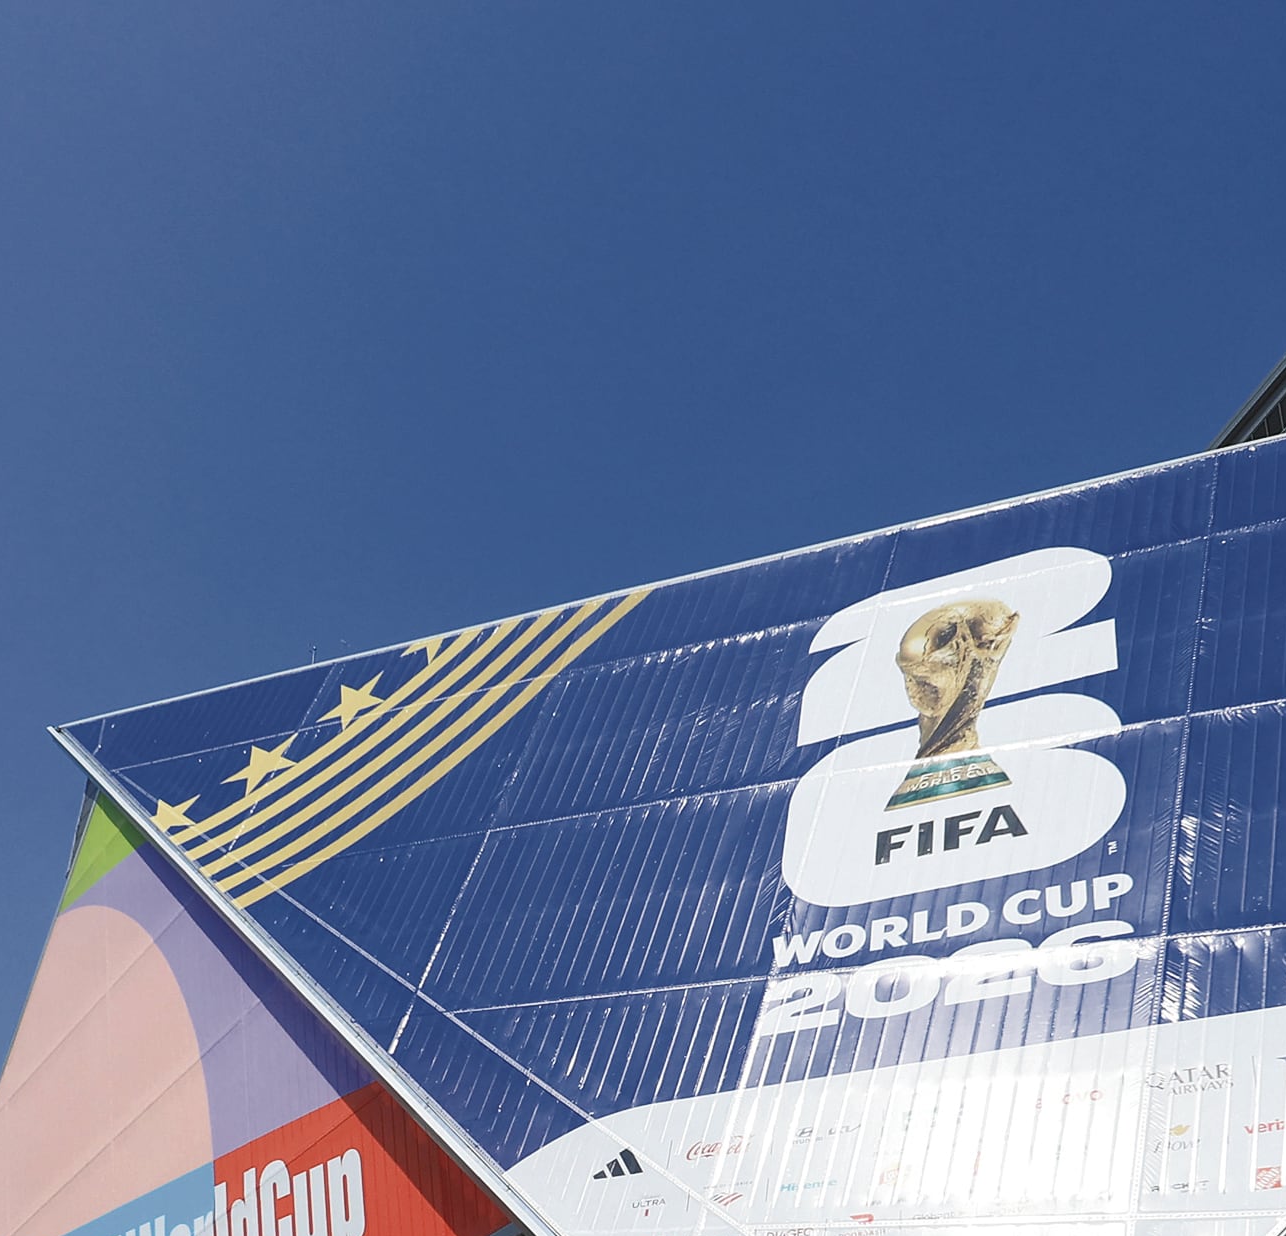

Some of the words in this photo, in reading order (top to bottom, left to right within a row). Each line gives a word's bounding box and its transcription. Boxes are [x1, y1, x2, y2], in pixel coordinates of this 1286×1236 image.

[875, 804, 1029, 866] FIFA
[772, 901, 990, 967] WORLD
[1002, 872, 1134, 926] CUP
[760, 920, 1138, 1037] 2026
[1145, 1063, 1230, 1090] QATAR
[1169, 1077, 1234, 1097] AIRWAYS
[686, 1135, 754, 1160] Cocaola
[780, 1178, 838, 1192] Hiene
[632, 1198, 666, 1209] ULTRA
